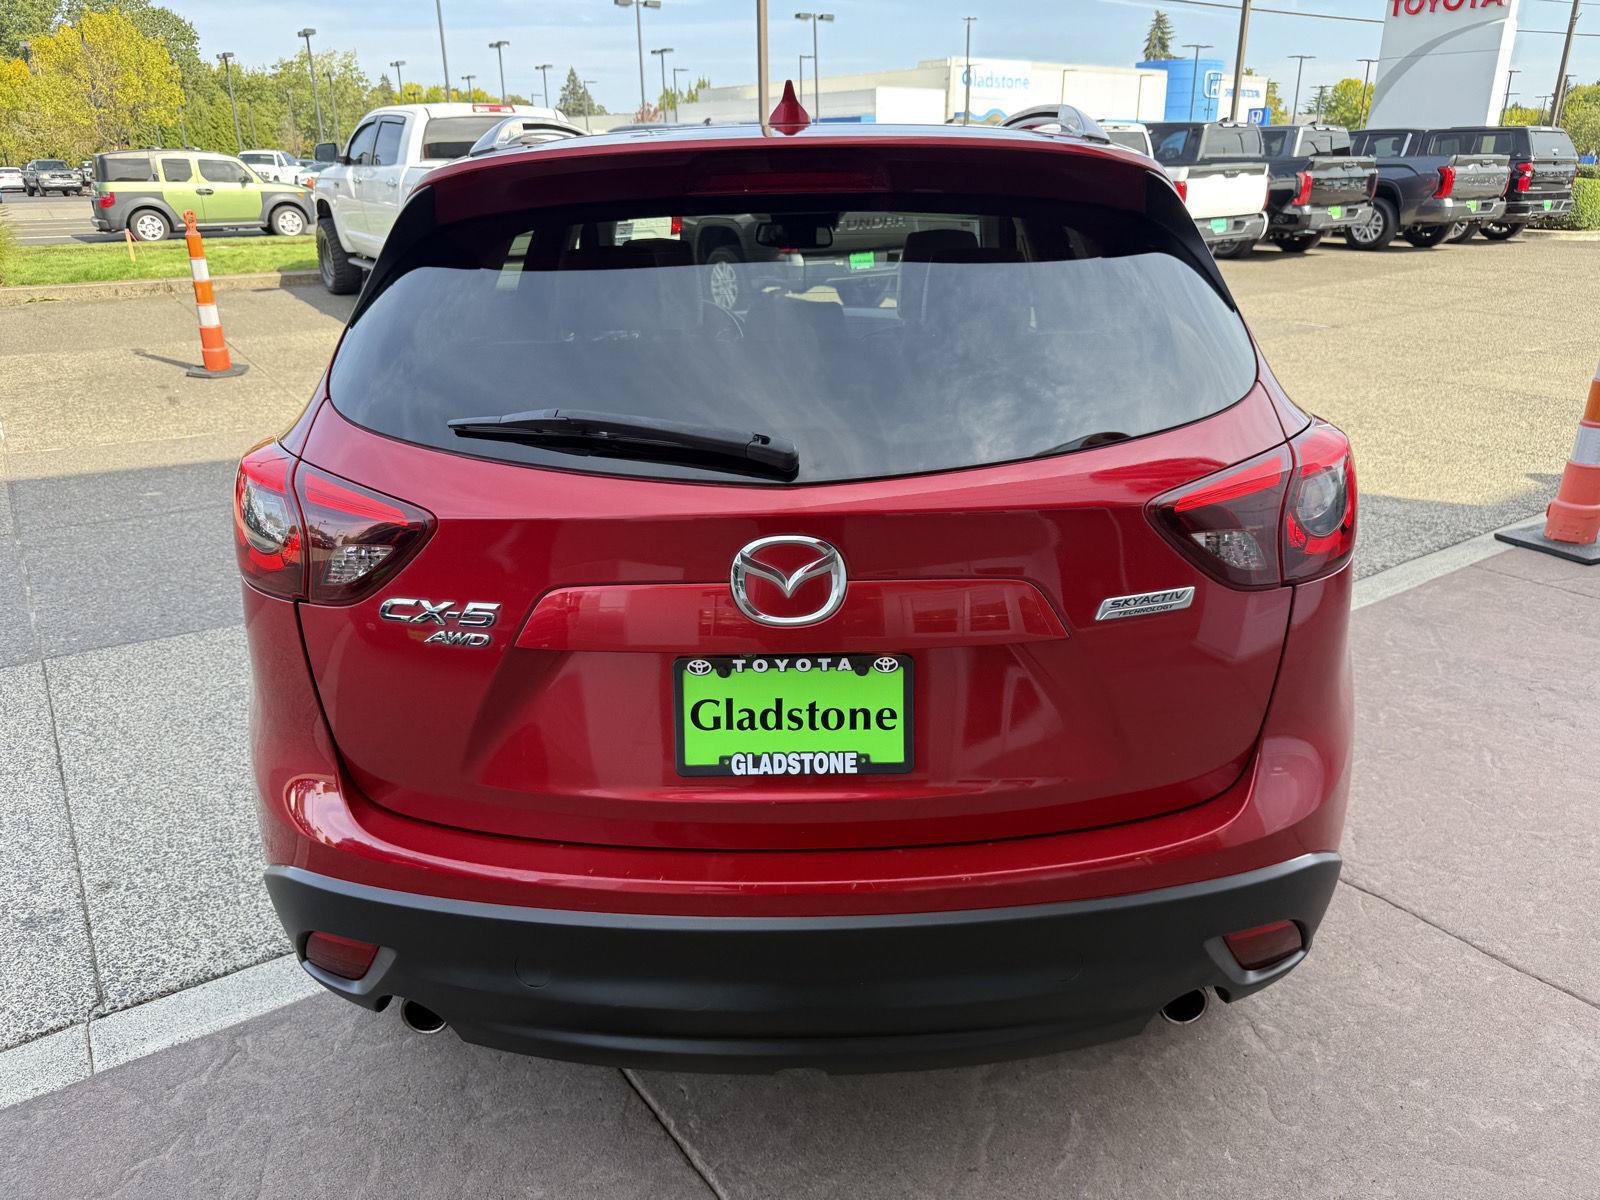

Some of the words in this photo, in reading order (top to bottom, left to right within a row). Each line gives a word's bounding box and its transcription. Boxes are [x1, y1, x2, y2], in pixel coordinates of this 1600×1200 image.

[962, 69, 1030, 90] Gladstone
[1109, 590, 1187, 609] SKYACTIV
[1118, 603, 1176, 616] TECHNOLOGY
[378, 597, 501, 628] CX-5
[423, 630, 491, 647] AWD
[732, 657, 853, 673] TOYOTA
[690, 697, 898, 731] Gladstone
[730, 751, 860, 776] GLADSTONE
